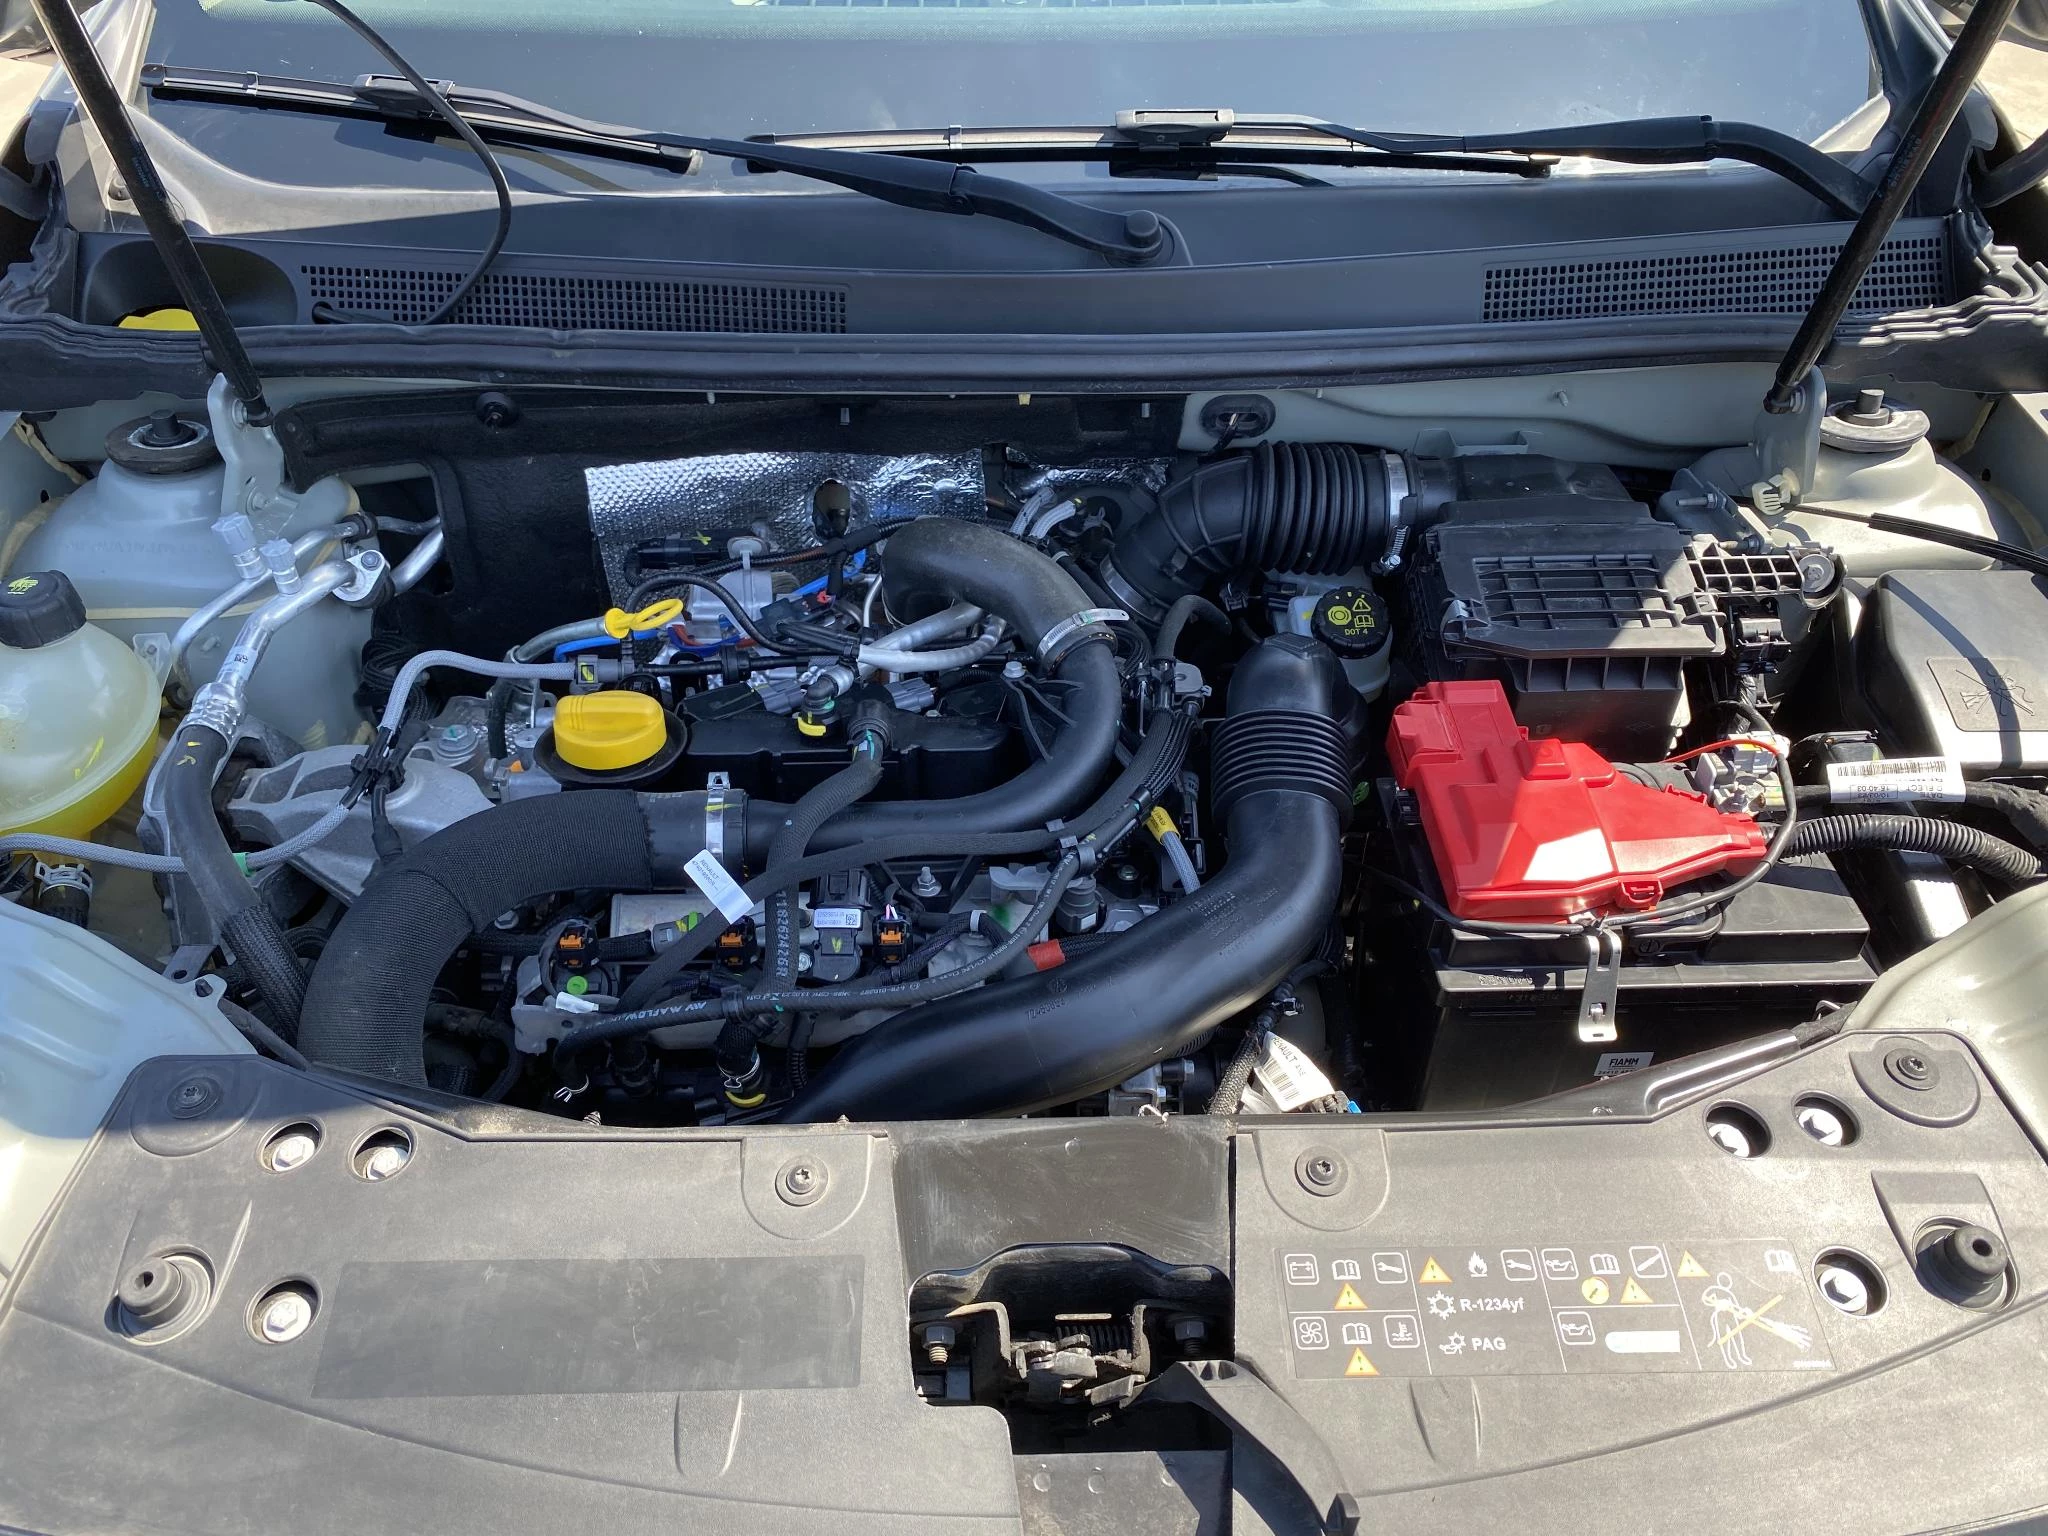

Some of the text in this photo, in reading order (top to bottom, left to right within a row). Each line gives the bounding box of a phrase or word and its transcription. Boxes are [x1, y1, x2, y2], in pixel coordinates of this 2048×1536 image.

[699, 859, 720, 881] RENAULT
[623, 1003, 683, 1022] MAFLOW
[1271, 1035, 1298, 1065] RENAULT
[1609, 1058, 1640, 1066] FIAMM
[1459, 1296, 1524, 1313] R-1234yf
[1471, 1337, 1507, 1351] PAG
